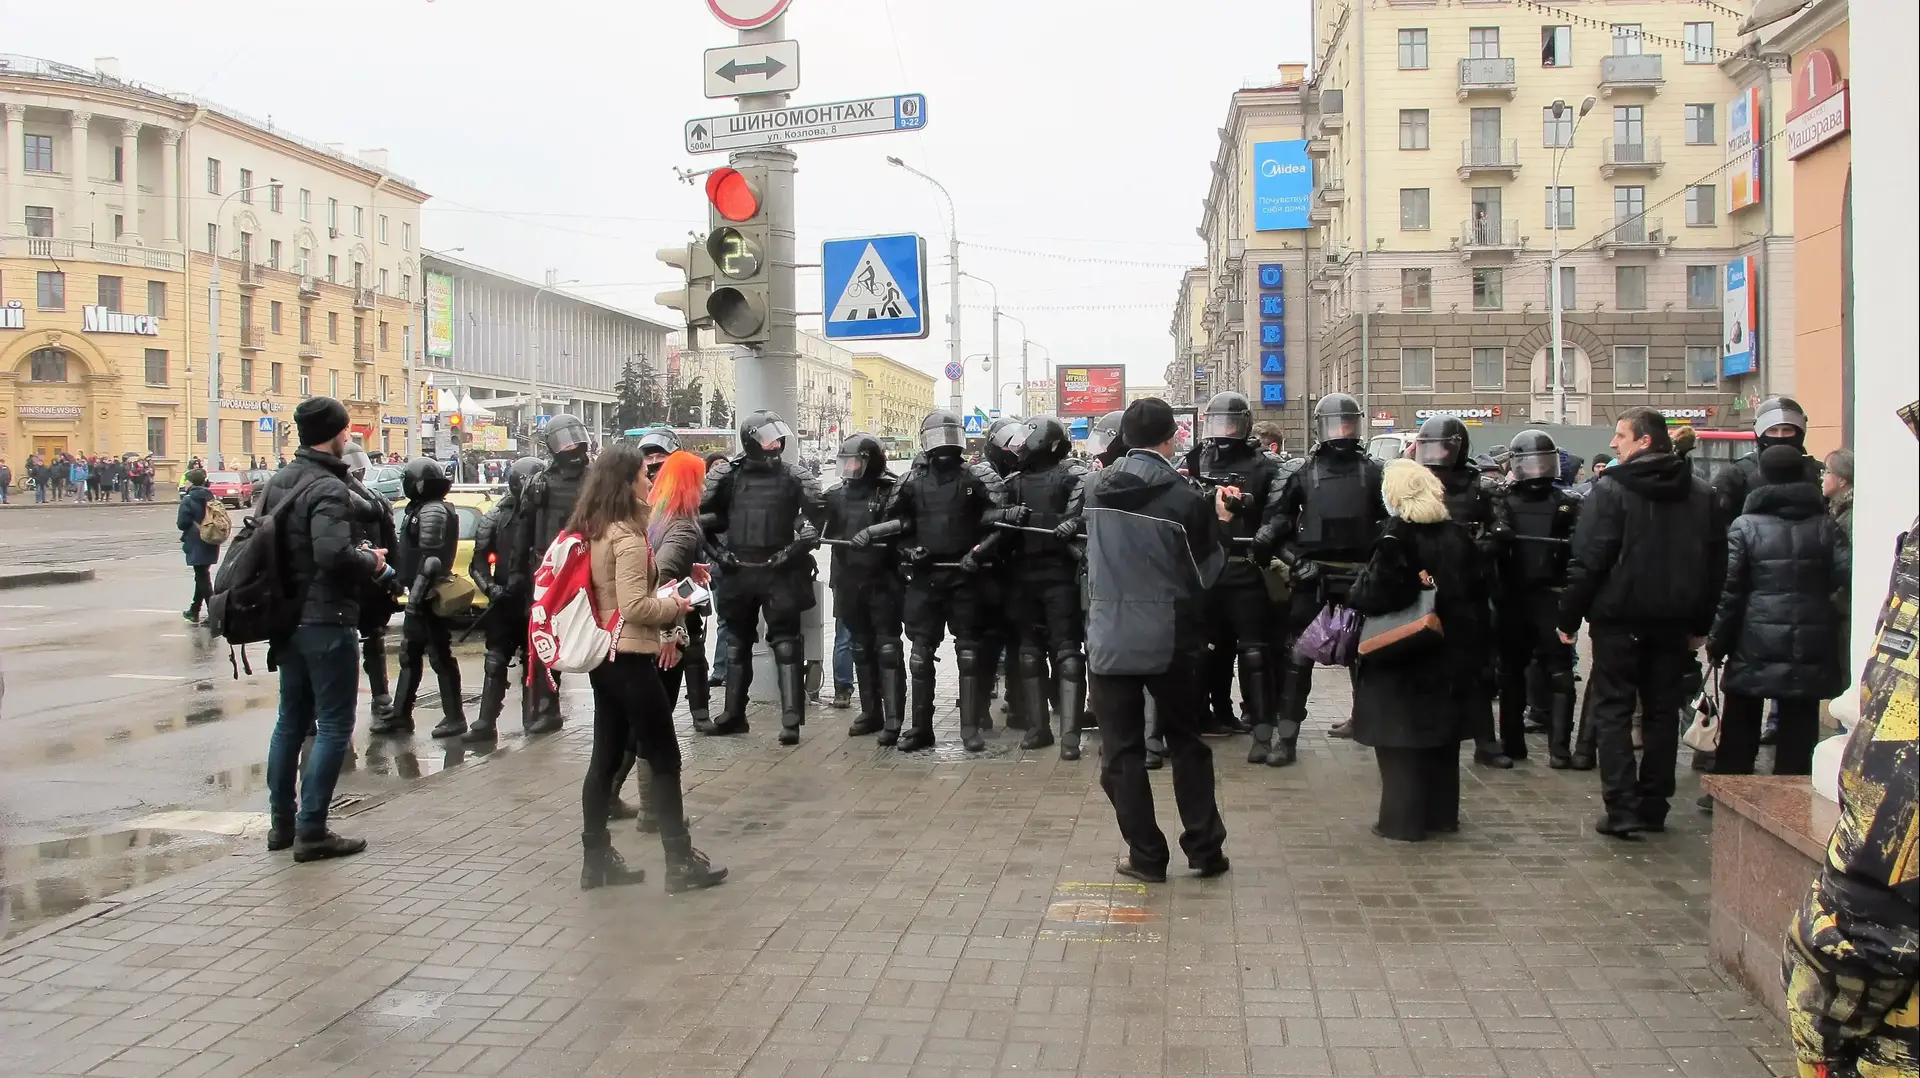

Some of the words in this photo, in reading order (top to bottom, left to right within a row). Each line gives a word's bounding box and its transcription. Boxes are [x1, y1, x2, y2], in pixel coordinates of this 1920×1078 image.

[1807, 58, 1817, 101] 1
[729, 101, 875, 133] ШИНОМОНТАЖ
[901, 117, 920, 128] 9-22
[767, 133, 782, 143] ул.
[784, 127, 830, 140] Козлова,
[832, 125, 837, 134] 8
[1788, 109, 1843, 153] Машэрава
[690, 142, 711, 151] 500м
[1264, 161, 1306, 176] Midea
[1259, 194, 1309, 205] Почувствуй
[1285, 204, 1306, 213] дома
[82, 305, 159, 336] Минск
[1262, 268, 1282, 401] ОКЕАН
[19, 406, 83, 415] MINSKNEWS.BY
[1377, 412, 1387, 420] 42
